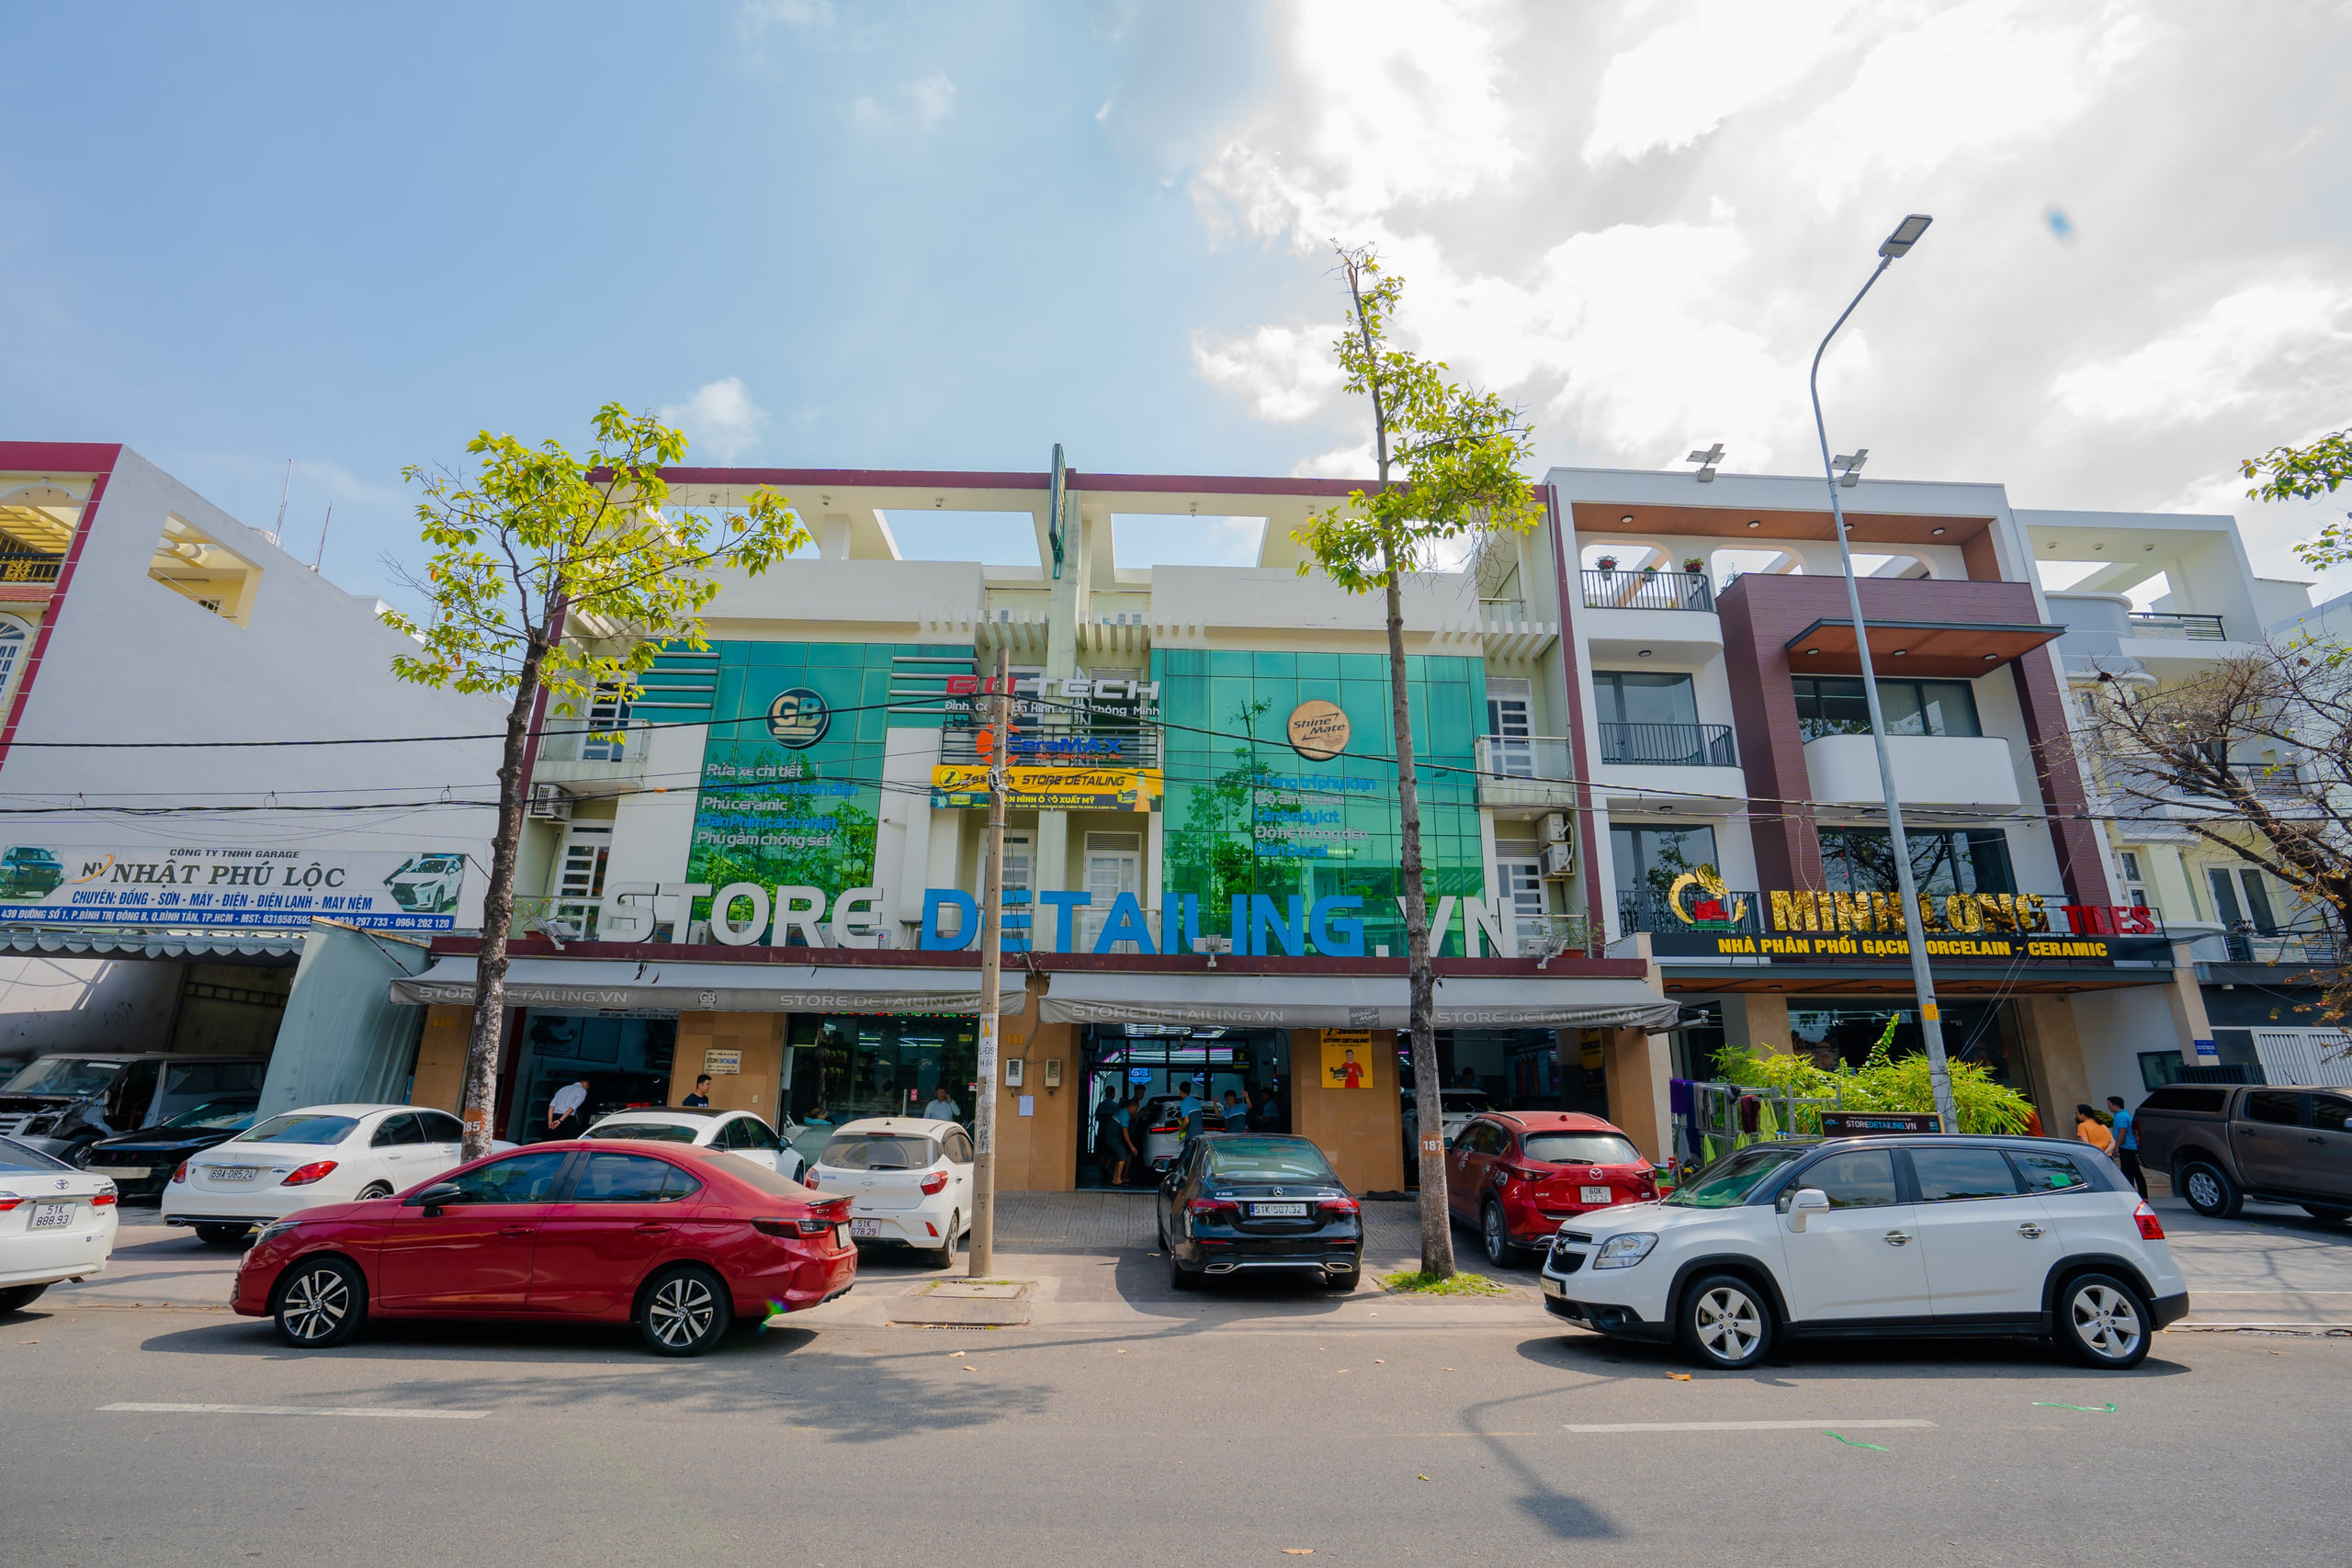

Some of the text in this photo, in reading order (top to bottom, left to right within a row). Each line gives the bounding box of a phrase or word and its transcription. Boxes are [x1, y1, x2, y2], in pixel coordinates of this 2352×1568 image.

[773, 695, 821, 727] GB
[1133, 705, 1160, 716] Minh
[1293, 717, 1332, 729] Shine
[1310, 724, 1345, 735] Mate
[1022, 774, 1063, 785] STORE
[1064, 775, 1125, 786] DETAILING
[730, 797, 788, 811] ceramic
[1017, 794, 1037, 803] HÌNH
[1038, 795, 1046, 804] Ô
[1282, 809, 1318, 825] body
[761, 829, 806, 850] chống
[808, 833, 833, 847] sét
[1254, 826, 1277, 841] Độ
[1298, 825, 1340, 843] thống
[169, 846, 201, 857] CÔNG
[222, 850, 252, 858] TNHH
[255, 851, 300, 859] GARAGE
[110, 859, 200, 888] NHẬT
[208, 861, 274, 886] PHÚ
[282, 862, 345, 892] LỘC
[72, 888, 118, 905] CHUYÊN:
[158, 890, 181, 906] SƠN
[189, 890, 214, 907] MÁY
[221, 891, 249, 910] ĐIỆN
[256, 892, 283, 910] ĐIỆN
[284, 895, 313, 910] LẠNH
[322, 897, 345, 910] MAY
[347, 895, 373, 912] NỆM
[1, 908, 17, 919] 439
[202, 913, 234, 923] TP.HCM
[356, 917, 372, 927] 297
[373, 918, 389, 928] 733
[416, 919, 433, 929] 202
[435, 919, 450, 929] 120
[600, 882, 884, 948] STORE
[1770, 890, 2156, 935] MINH LONG TILES
[1718, 934, 2109, 957] NHÀ PHÂN PHỐI GẠCH ORCELAIN CERAMIC
[419, 987, 628, 1004] STOR ETAILING.VN
[779, 994, 848, 1009] STORE
[1071, 1005, 1284, 1022] STORE DETAILING.VN
[1437, 1010, 1504, 1023] STORE
[1423, 1140, 1442, 1152] 187
[47, 1204, 65, 1215] 51K
[36, 1214, 70, 1226] 888.93
[857, 1219, 872, 1228] 51K
[851, 1227, 876, 1236] 078.29
